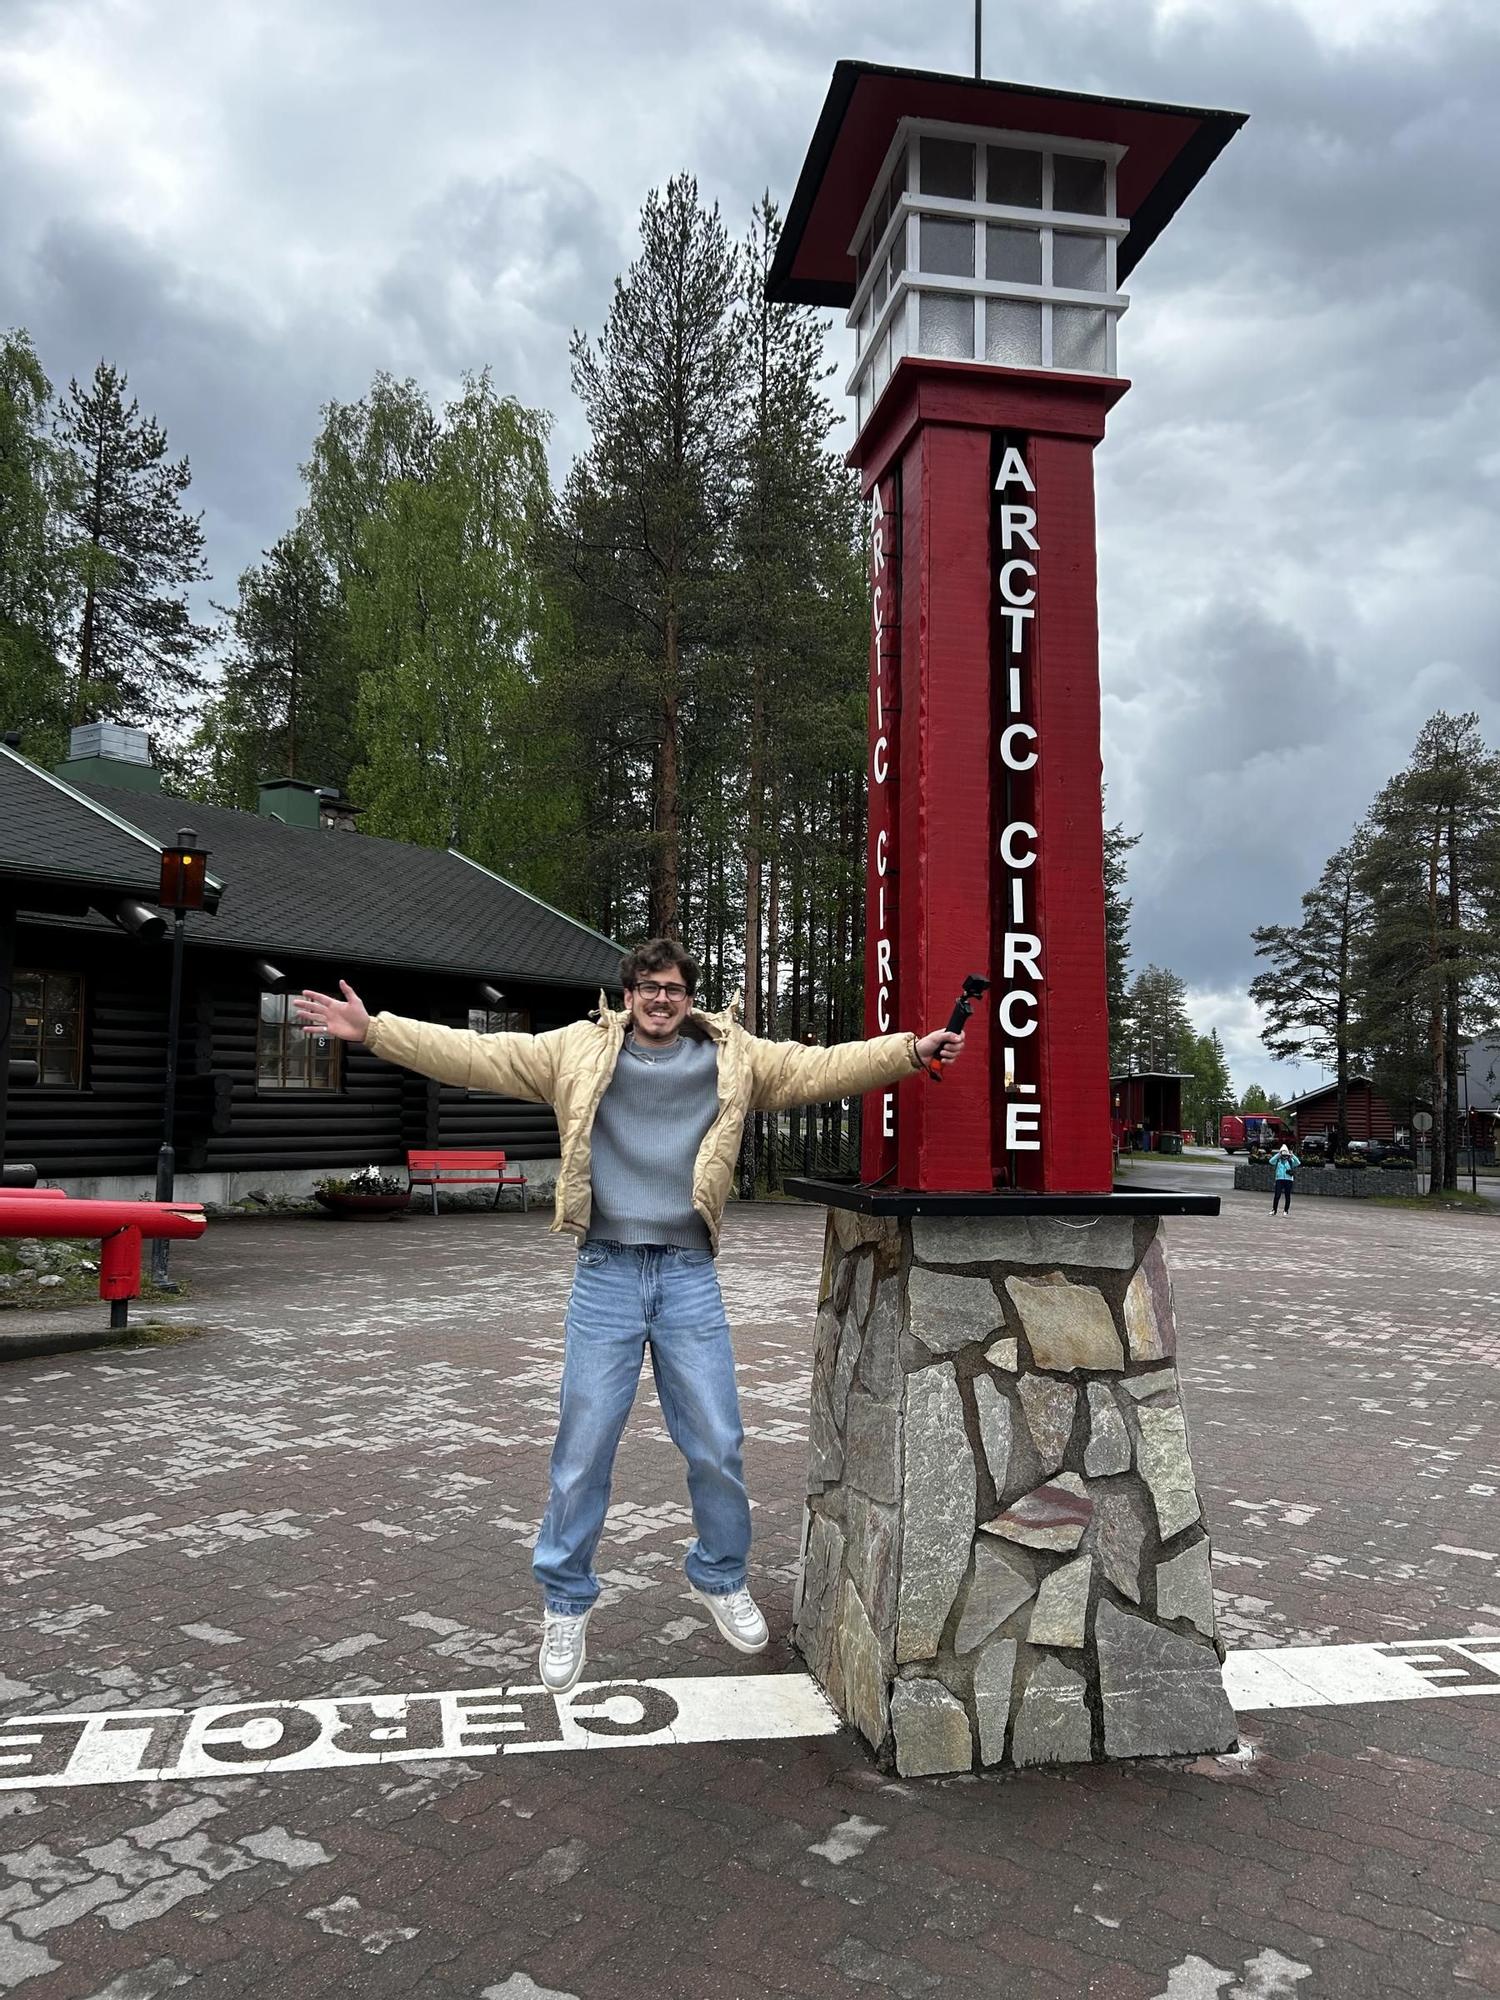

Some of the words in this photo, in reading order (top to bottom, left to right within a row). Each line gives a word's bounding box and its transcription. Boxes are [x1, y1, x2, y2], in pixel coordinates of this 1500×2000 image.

[871, 483, 889, 784] ARCTIC
[995, 447, 1040, 771] ARCTIC
[876, 830, 895, 1137] CIRCE
[999, 822, 1044, 1150] CIRCLE
